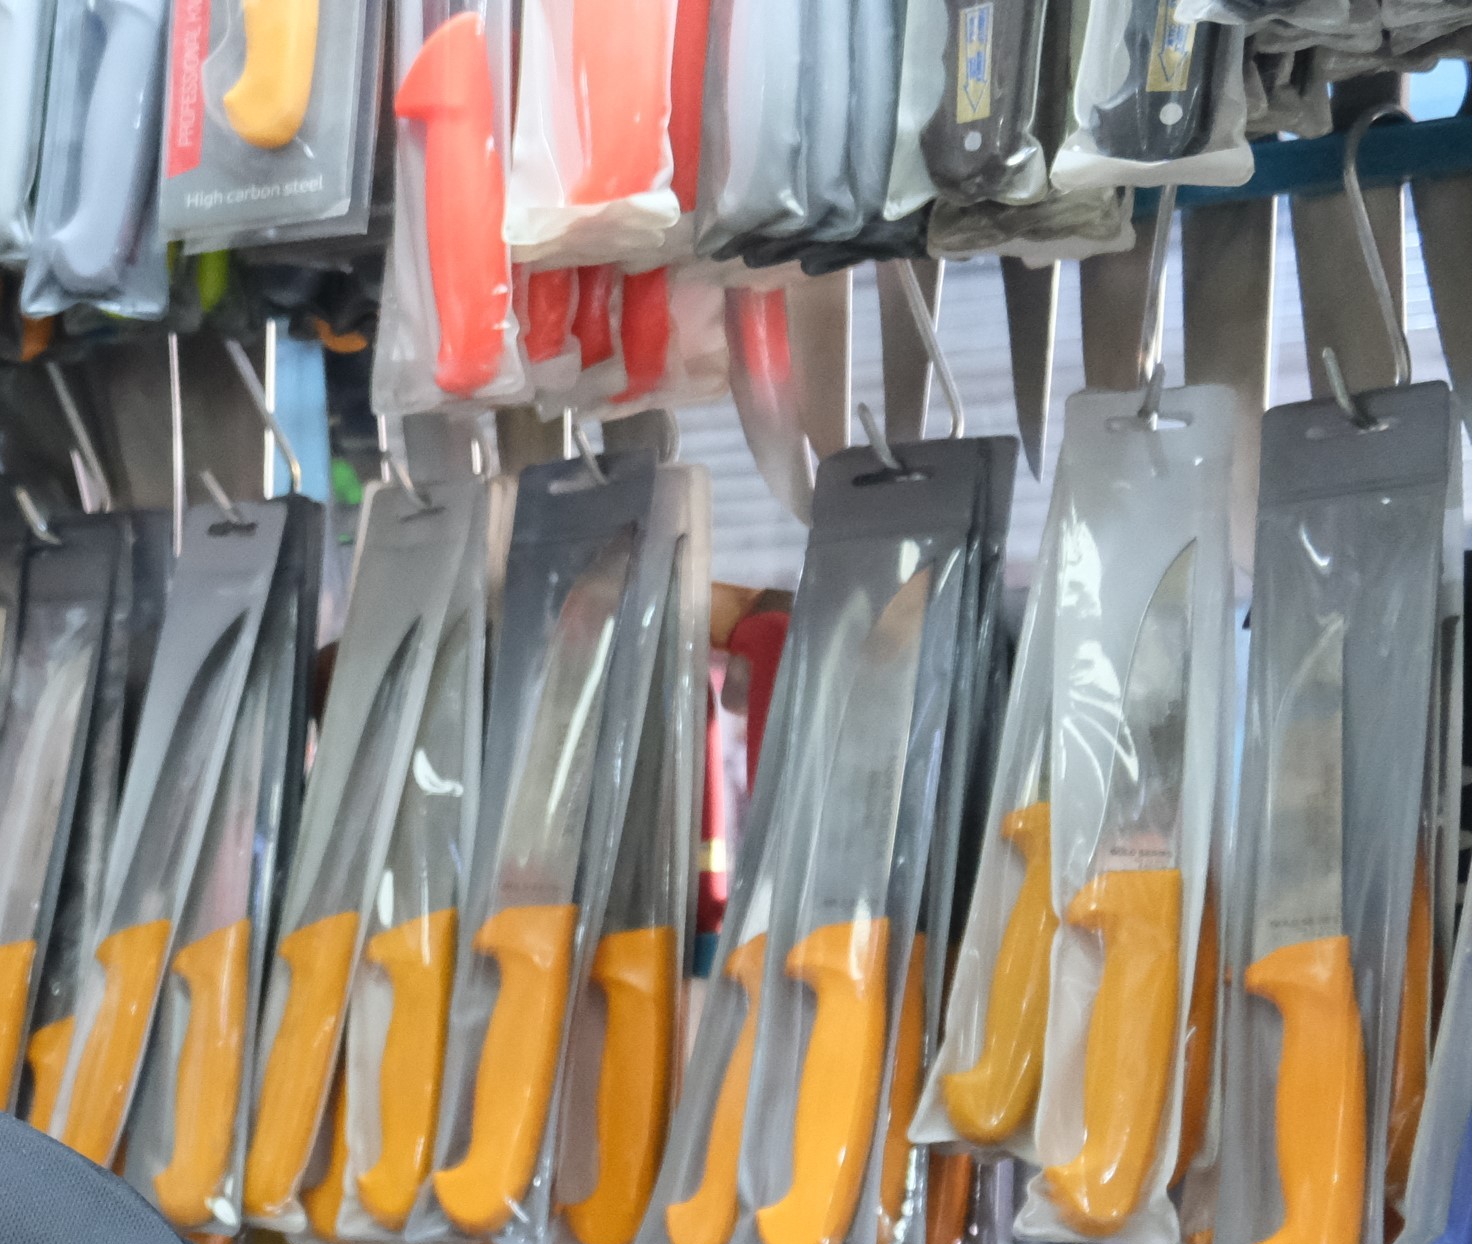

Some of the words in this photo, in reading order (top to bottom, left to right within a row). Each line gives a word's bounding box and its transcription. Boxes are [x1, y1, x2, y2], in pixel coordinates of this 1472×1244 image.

[186, 191, 223, 209] High
[226, 181, 280, 201] carbon
[282, 175, 323, 194] steel
